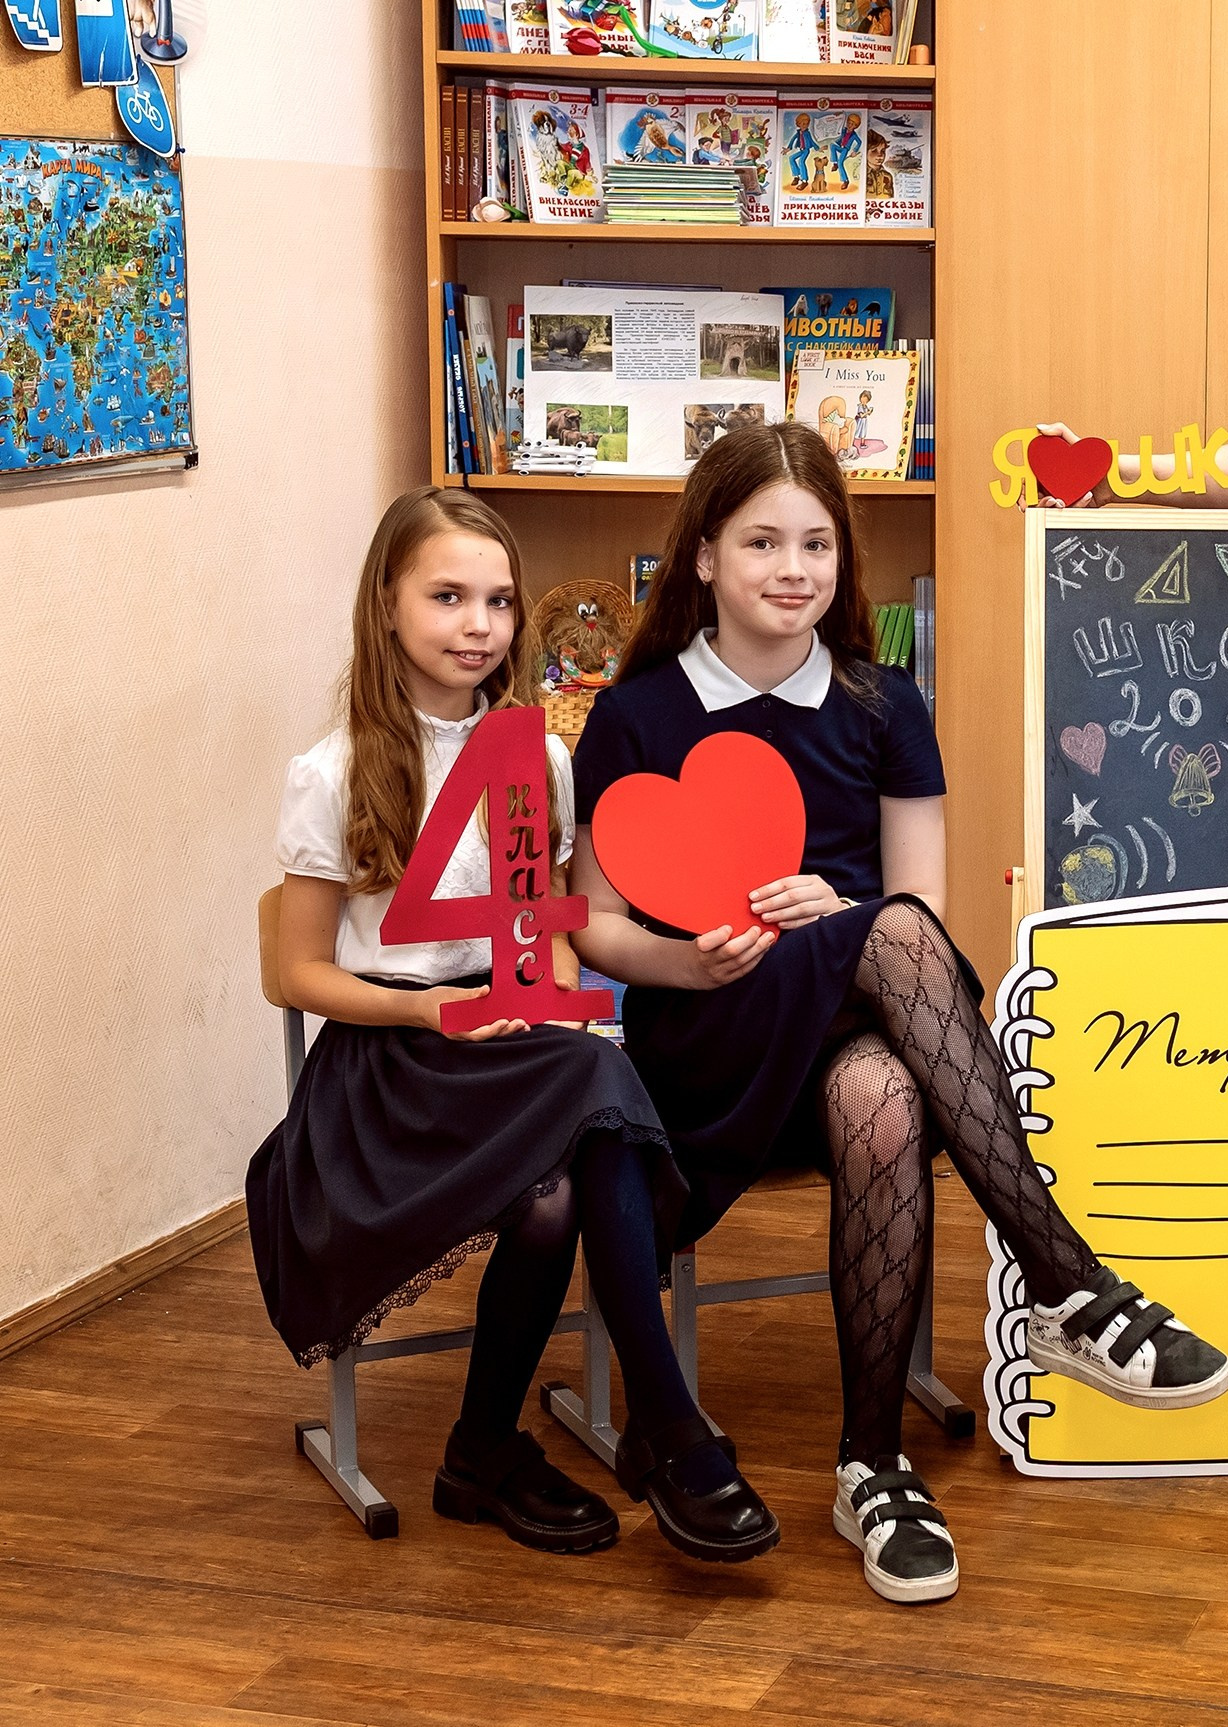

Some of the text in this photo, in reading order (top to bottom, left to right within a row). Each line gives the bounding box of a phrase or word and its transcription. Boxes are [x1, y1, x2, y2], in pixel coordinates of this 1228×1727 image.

[838, 40, 892, 52] ПРИКЛЮЧЕНИЯ
[570, 104, 589, 116] 3-4
[41, 159, 102, 179] КАРТА МИРА
[539, 196, 600, 207] ВНЕКЛАССНОЕ
[549, 207, 594, 218] ЧТЕНИЕ
[781, 211, 859, 220] ЭЛЕКТРОНИКА
[884, 209, 923, 220] ВОЙНЕ
[784, 317, 883, 338] ИВОТНЫЕ
[805, 341, 879, 351] НАКЛЕЙКАМИ
[825, 368, 886, 382] I Miss You
[988, 427, 1039, 508] Я
[380, 706, 615, 1034] 4
[506, 784, 545, 987] класс
